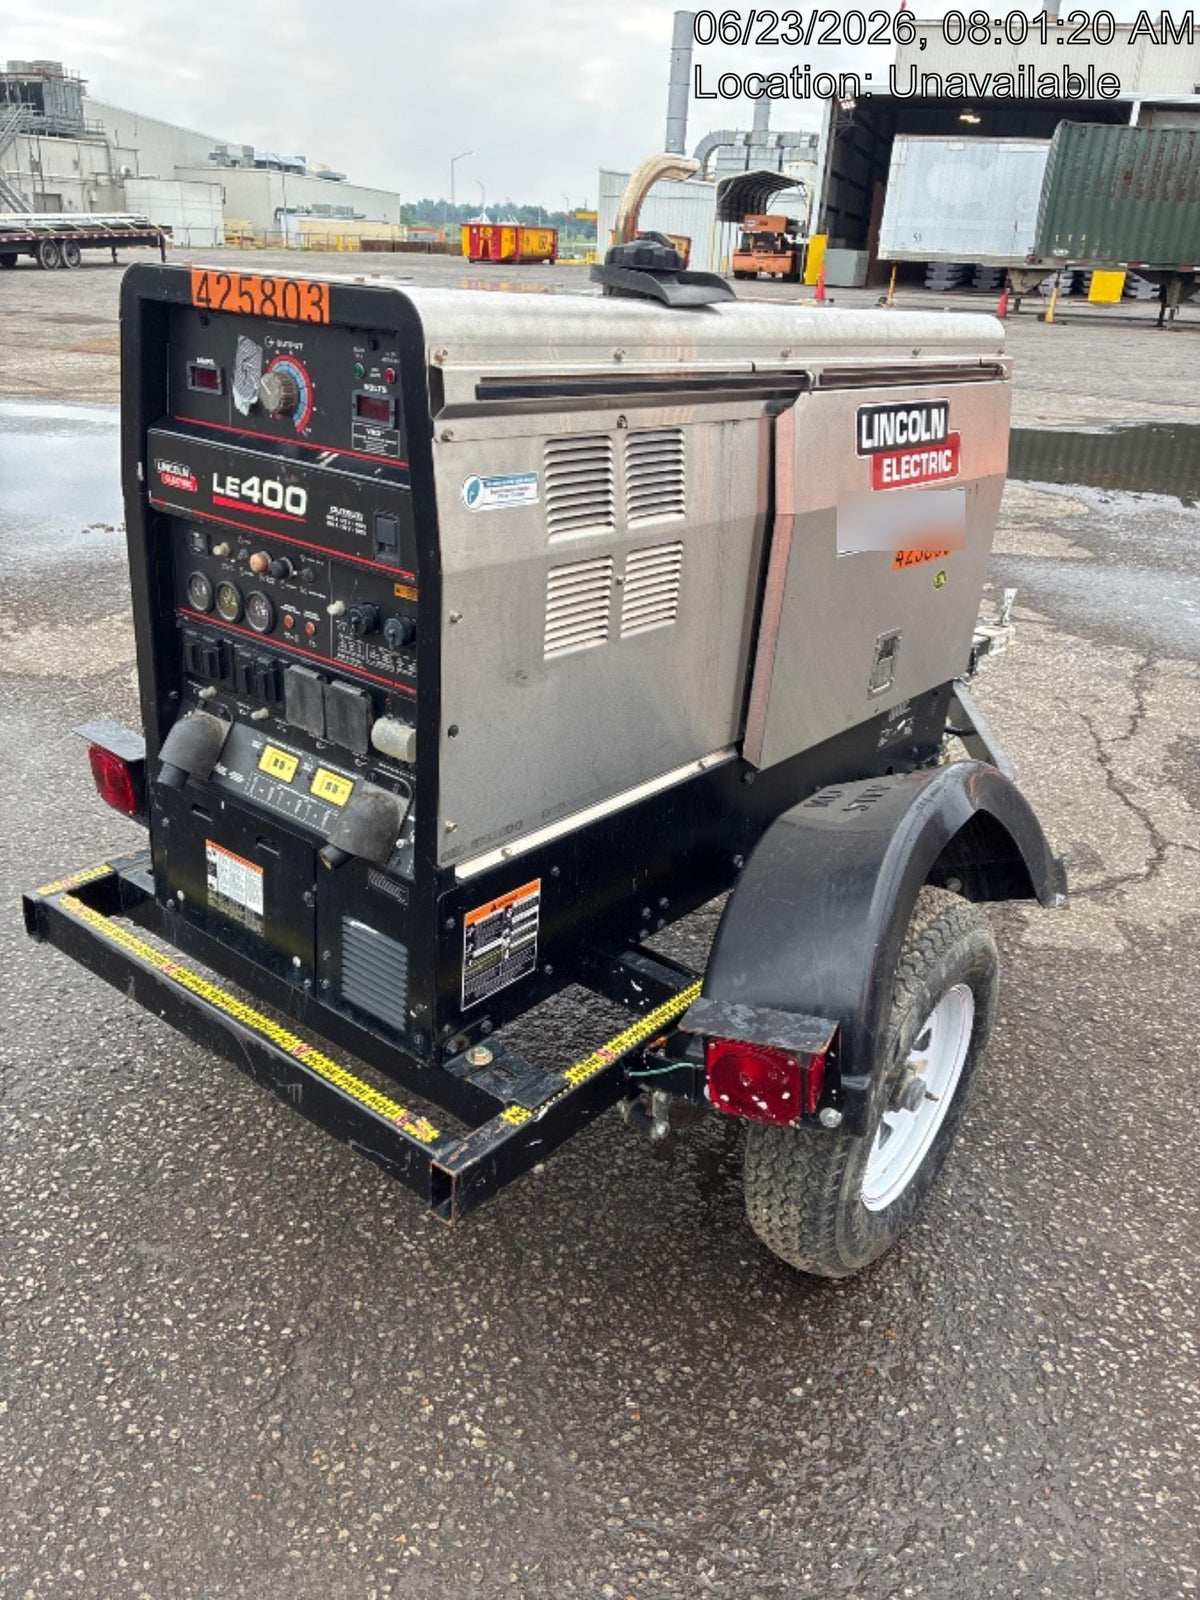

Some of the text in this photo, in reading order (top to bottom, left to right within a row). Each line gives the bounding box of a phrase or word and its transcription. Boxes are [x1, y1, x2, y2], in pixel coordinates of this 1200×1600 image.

[196, 271, 324, 323] 425803
[862, 407, 946, 449] LINCOLN
[882, 449, 952, 483] ELECTRIC
[212, 472, 308, 516] LE400
